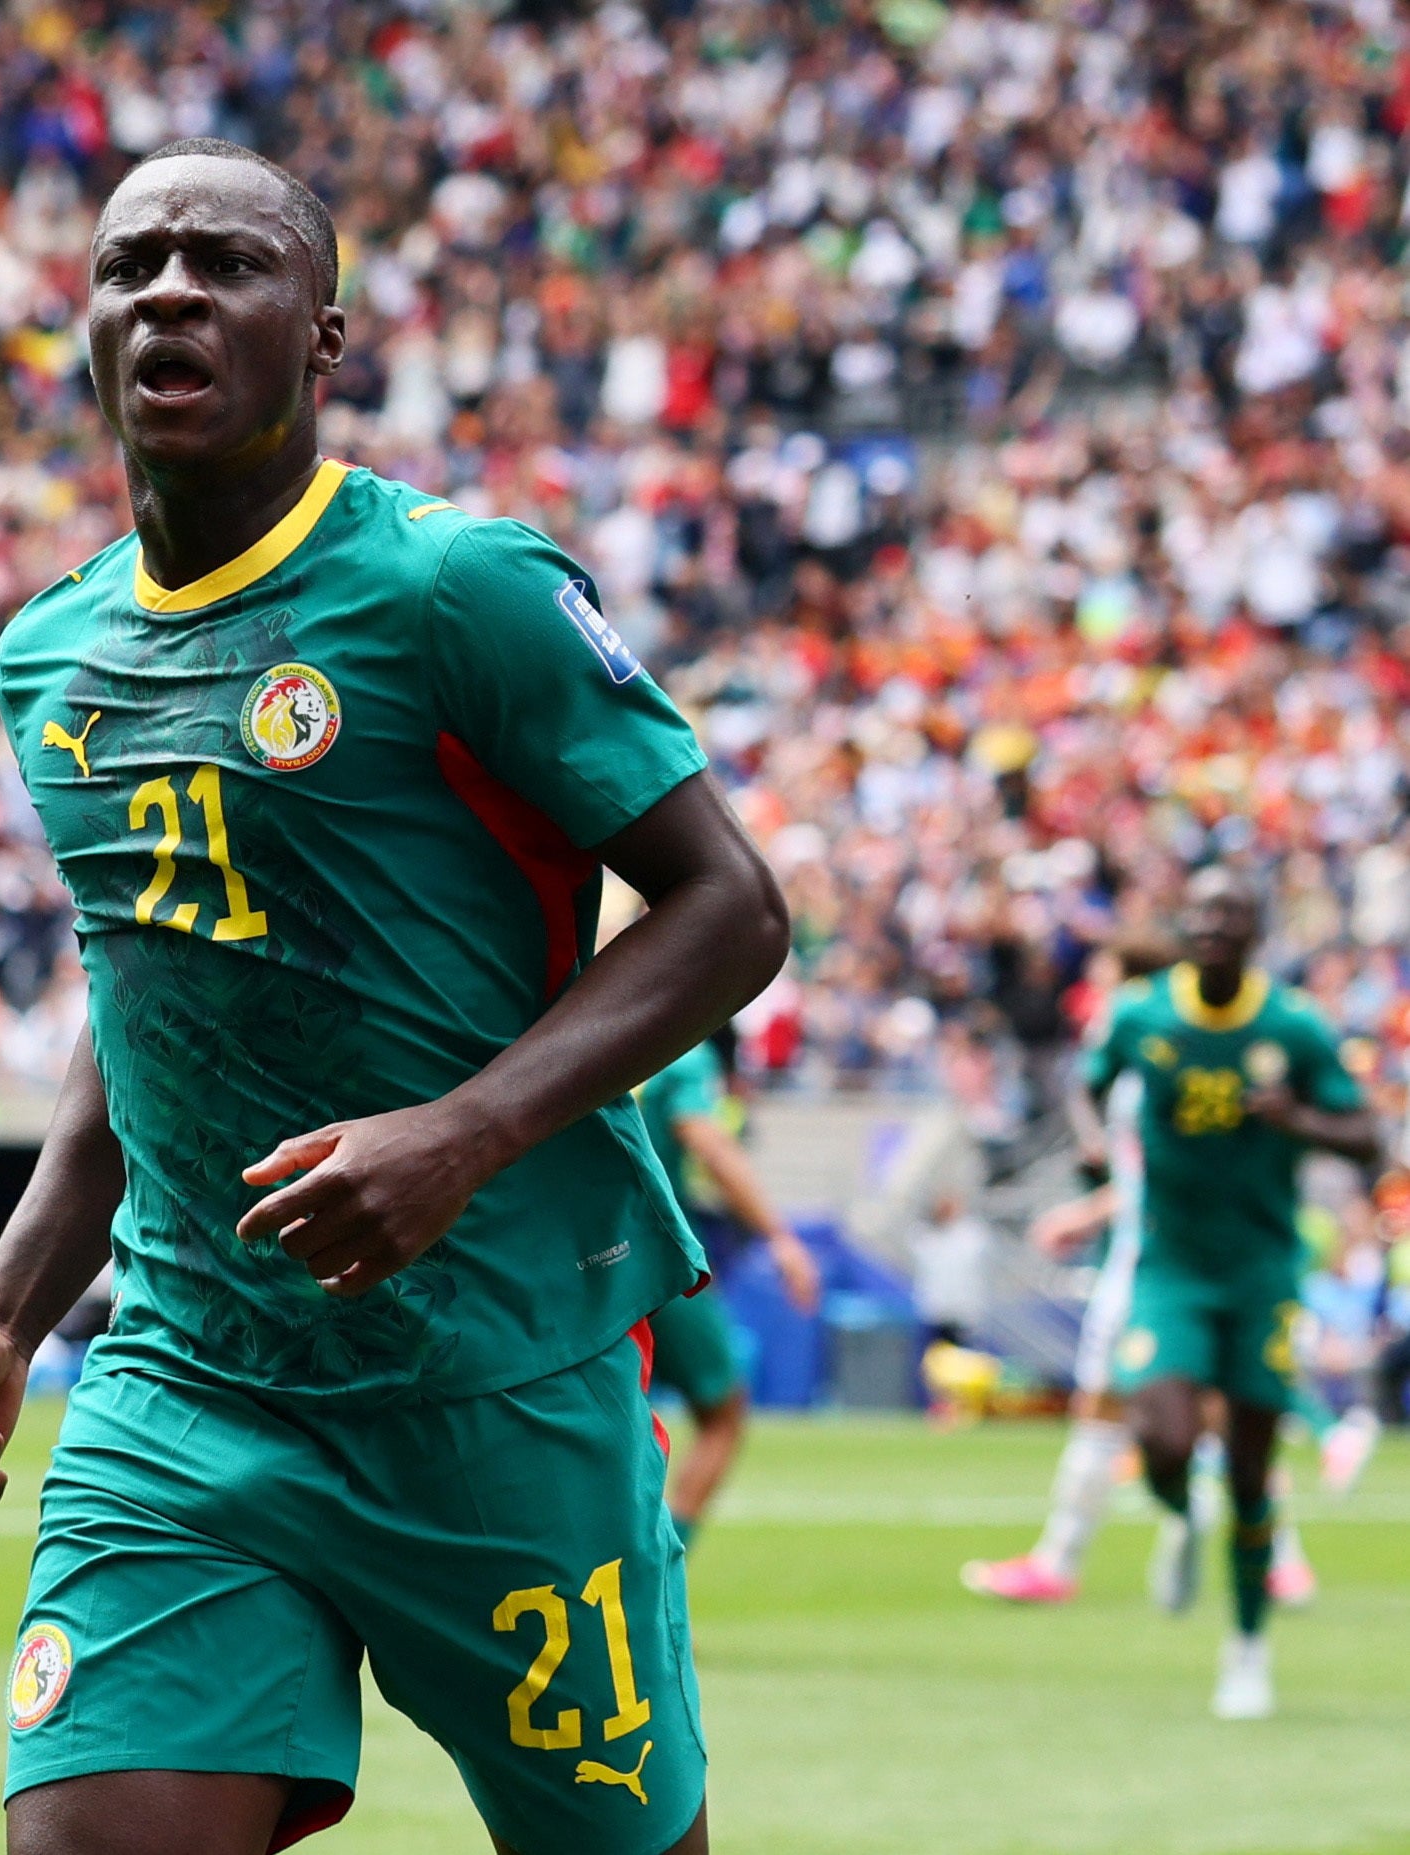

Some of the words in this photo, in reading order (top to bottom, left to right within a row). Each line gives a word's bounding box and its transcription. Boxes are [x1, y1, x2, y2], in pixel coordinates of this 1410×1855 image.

[274, 742, 326, 767] FOOTBALL
[128, 763, 268, 941] 21
[492, 1558, 651, 1750] 21
